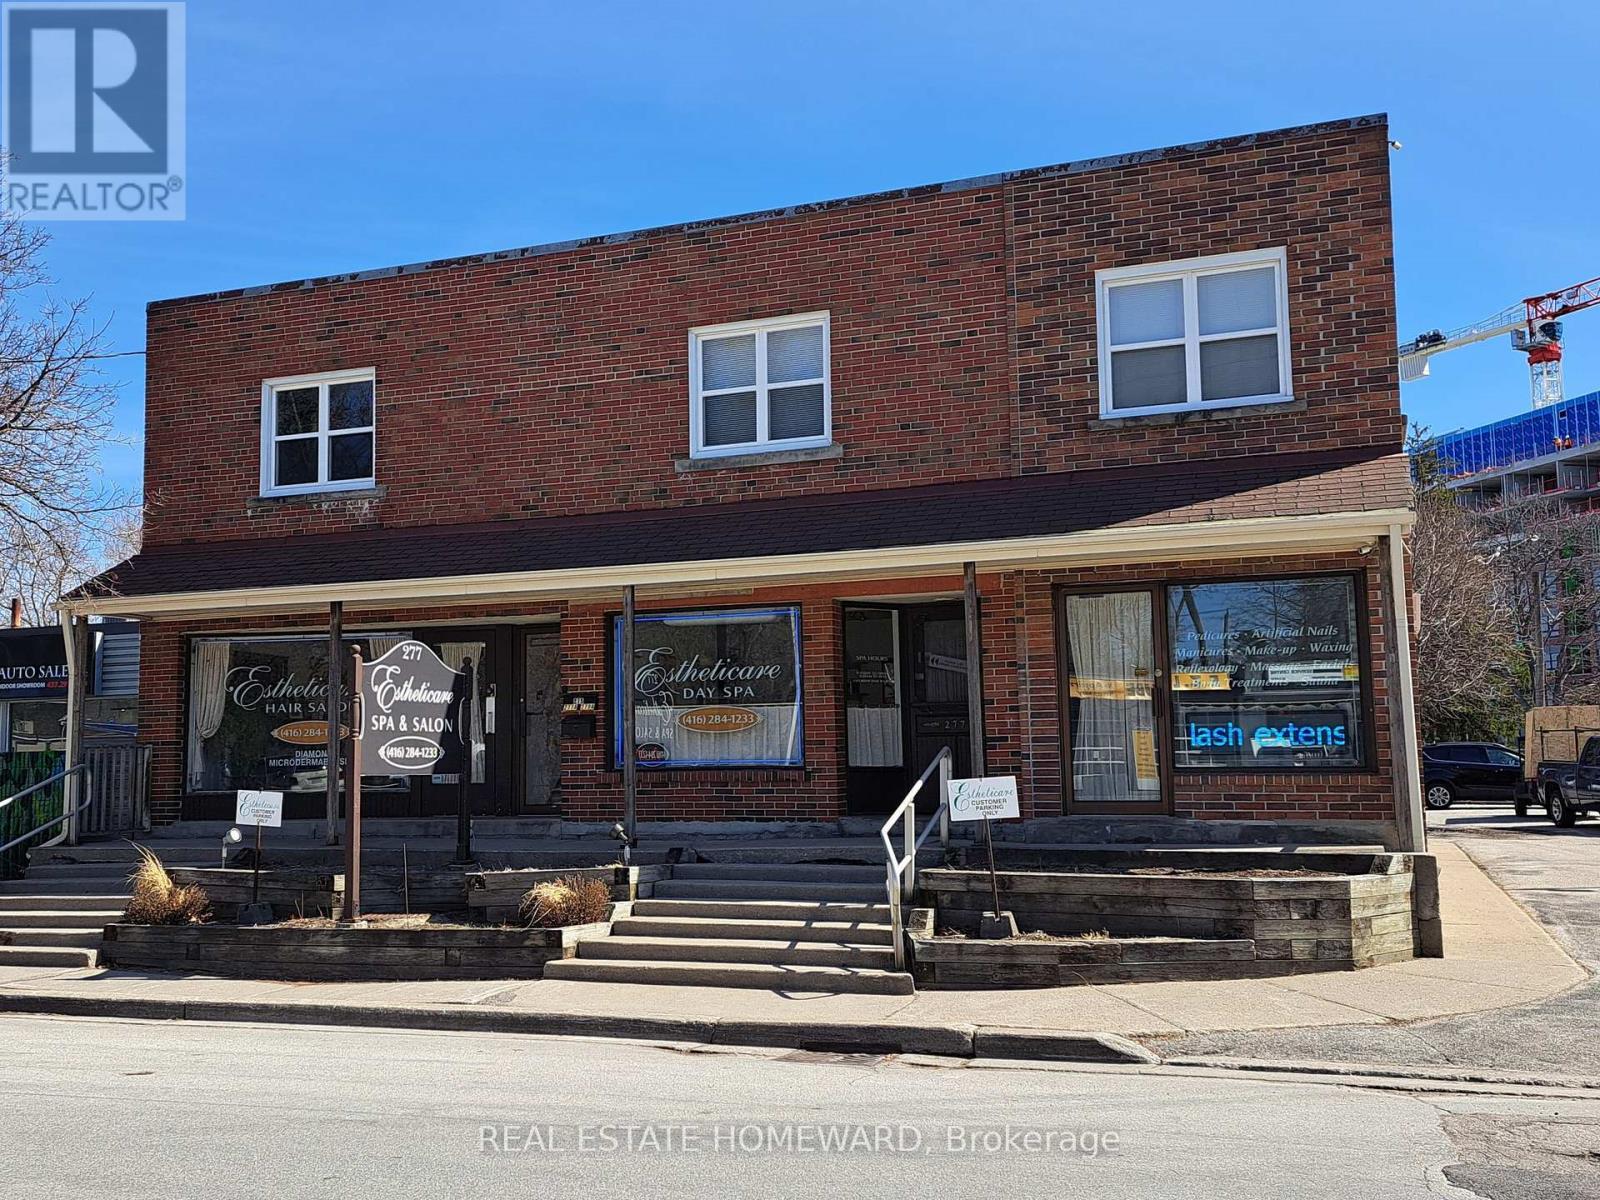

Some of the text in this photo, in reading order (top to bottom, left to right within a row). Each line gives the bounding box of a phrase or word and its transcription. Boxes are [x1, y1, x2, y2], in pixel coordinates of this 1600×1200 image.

[1187, 625, 1339, 641] Pedicures Artificial Nails
[402, 645, 422, 661] 277
[1175, 642, 1353, 657] Manicures Make-up Waxing
[0, 665, 69, 680] AUTO SALE
[634, 647, 782, 697] Estheticare
[1175, 663, 1239, 674] Reflexology
[370, 664, 454, 713] Estheticare
[683, 686, 755, 699] DAY SPA
[265, 701, 350, 714] HAIR SAO
[371, 715, 453, 732] SPA & SALON
[682, 713, 755, 725] (416) 284-1233
[280, 725, 346, 737] (416) 284-13
[1190, 722, 1345, 747] lash extens
[295, 750, 329, 758] DIAMON
[386, 747, 438, 759] (416) 284-1233
[950, 781, 1014, 811] Estheticare
